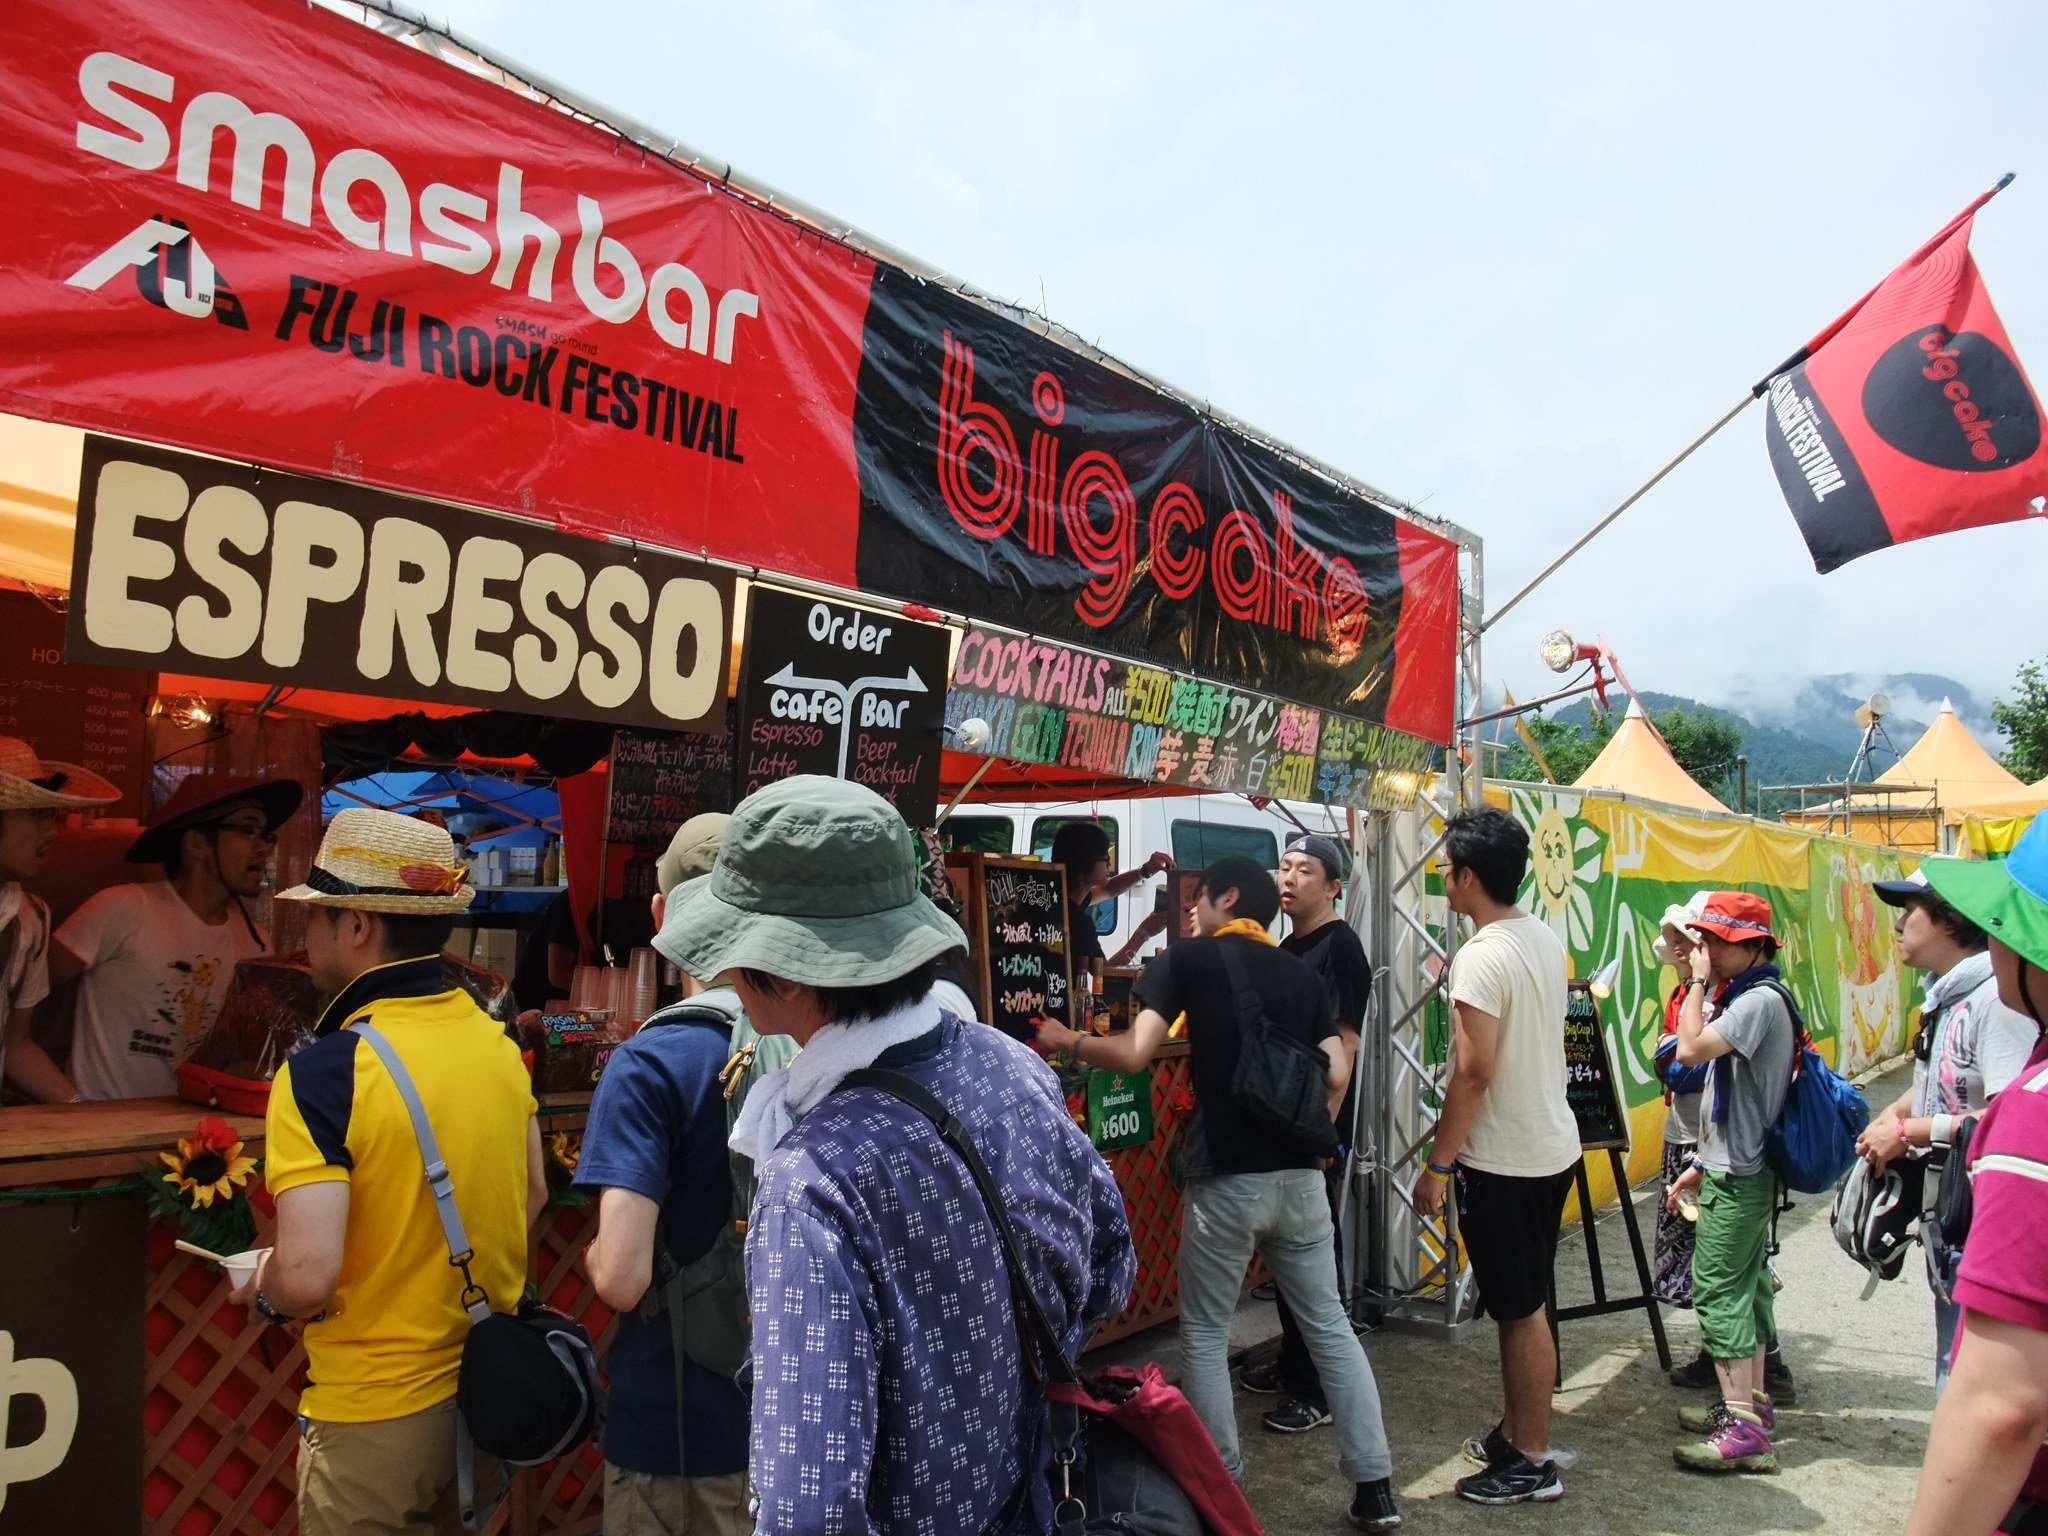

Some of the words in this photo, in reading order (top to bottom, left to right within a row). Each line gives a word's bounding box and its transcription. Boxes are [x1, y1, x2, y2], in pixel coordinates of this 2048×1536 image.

[496, 314, 548, 339] SMASH
[568, 337, 598, 356] round
[276, 274, 407, 367] FUJI
[420, 314, 560, 408] ROCK
[560, 352, 745, 464] FESTIVAL
[1786, 418, 1846, 503] FESTIVAL
[85, 460, 723, 720] ESPRESSO
[808, 603, 892, 655] Order
[32, 648, 66, 665] HO
[87, 687, 109, 698] 400
[111, 690, 131, 701] yen
[955, 630, 1111, 712] COCKTAILS
[1103, 686, 1125, 716] ALL
[1125, 665, 1172, 726] ¥500
[1165, 676, 1231, 737] 焼酎
[1225, 694, 1279, 747] ワイン
[110, 708, 129, 720] yen
[770, 689, 843, 725] cafe
[860, 692, 910, 729] Bar
[109, 726, 128, 737] yen
[750, 719, 823, 748] Espresso
[1011, 704, 1066, 764] GIN
[1061, 712, 1130, 774] TEQUILA
[107, 744, 128, 755] yen
[857, 733, 898, 761] Beer
[1269, 751, 1283, 767] ALL
[106, 762, 126, 774] yen
[748, 752, 798, 776] Latte
[853, 755, 922, 785] Cocktail
[1266, 755, 1316, 801] ¥500
[1049, 972, 1067, 995] ¥300
[541, 1014, 577, 1028] RAISIN
[1102, 1092, 1135, 1108] Heineken
[1101, 1110, 1140, 1141] ¥600
